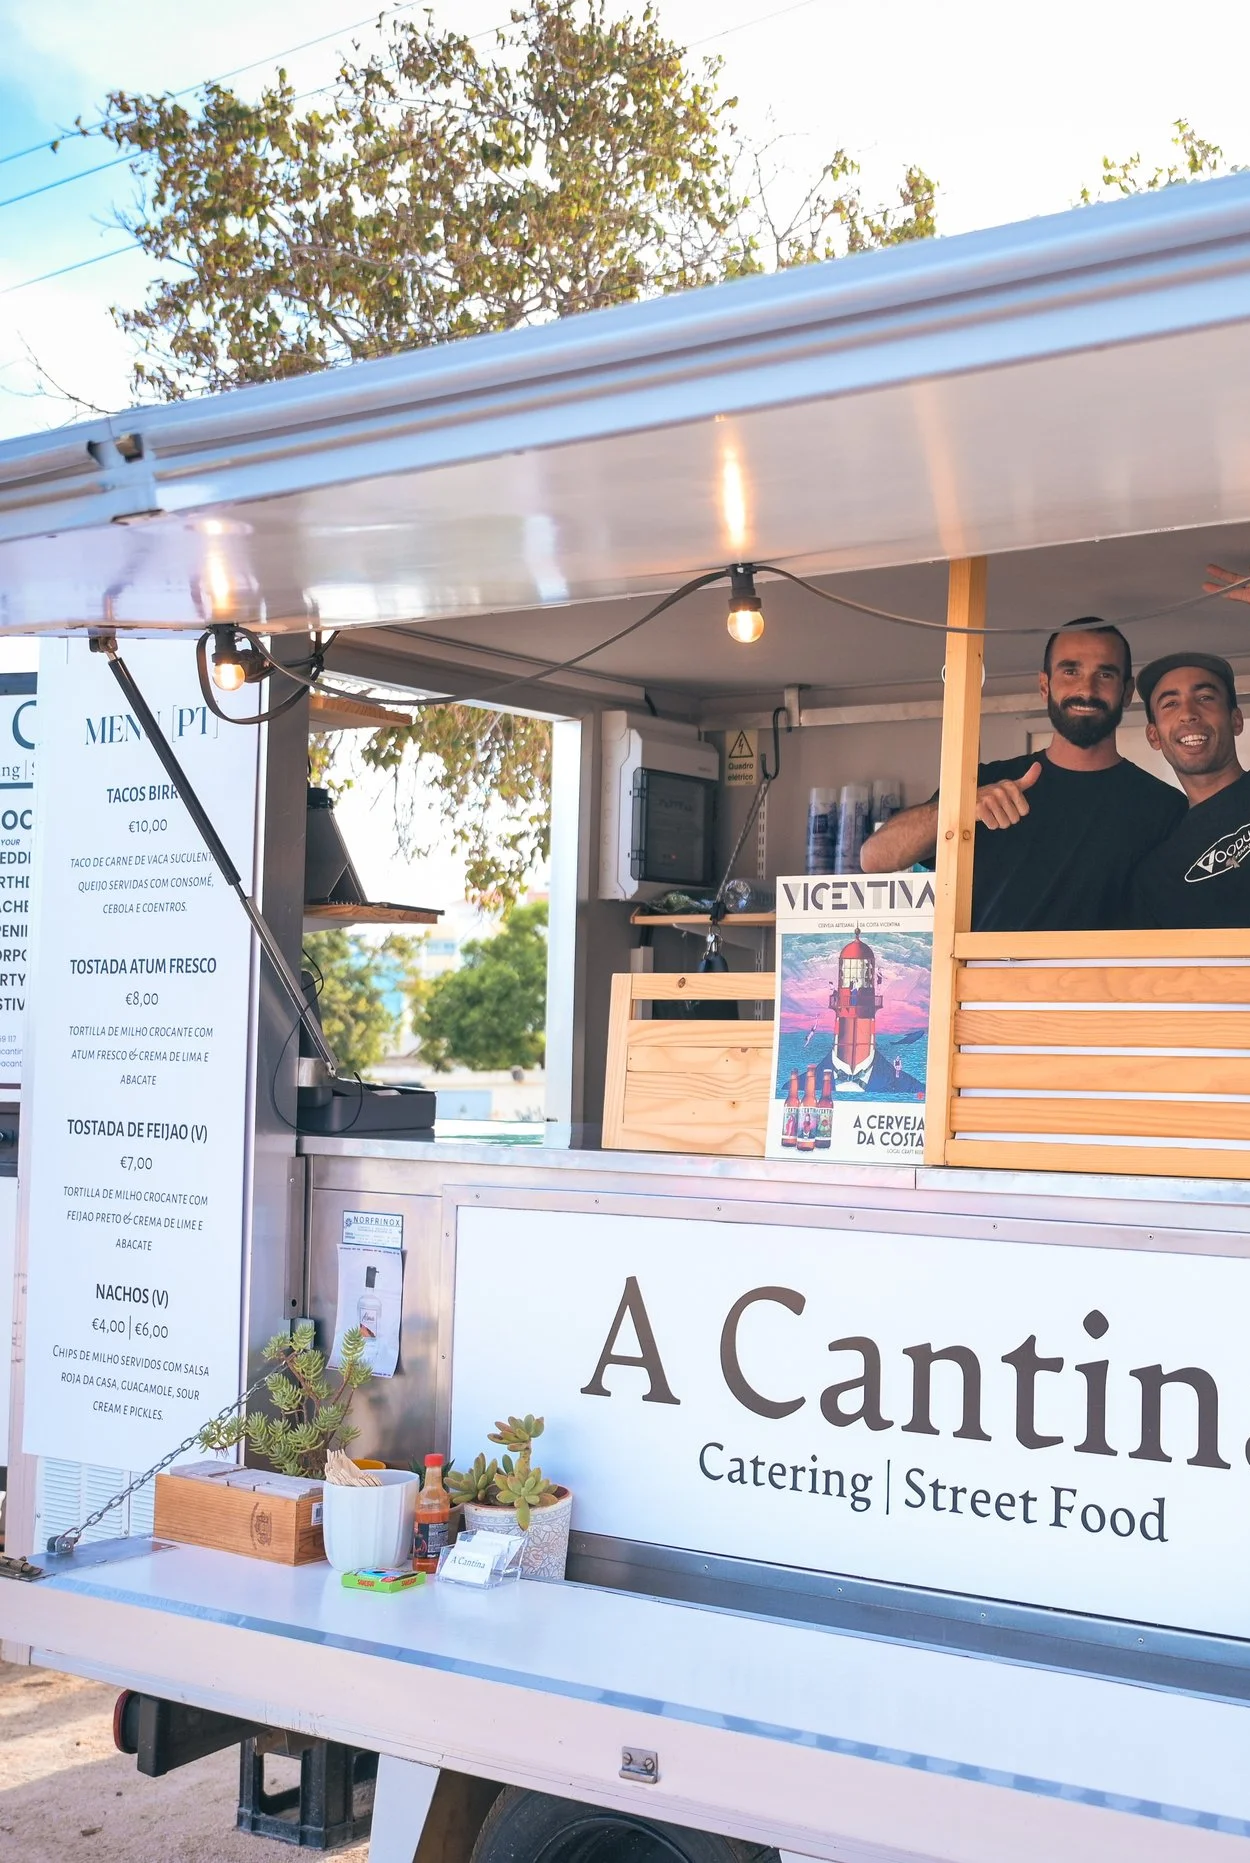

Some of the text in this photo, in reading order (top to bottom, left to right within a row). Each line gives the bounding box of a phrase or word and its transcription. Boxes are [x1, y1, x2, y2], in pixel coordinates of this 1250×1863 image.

[727, 762, 754, 771] Quadro
[727, 772, 754, 781] elétrico
[106, 786, 146, 803] TACOS
[128, 818, 168, 834] €10,00
[78, 872, 214, 893] QUEIJO SERVIDAS COM CONSOMÉ,
[782, 879, 935, 911] VICENTINA
[102, 901, 187, 914] CEBOLA E COENTROS.
[70, 957, 217, 975] TOSTADA ATUM FRESCO
[125, 991, 159, 1008] €8,00
[69, 1025, 213, 1038] TORTILLA DE MILHO CROCANTE COM
[120, 1074, 157, 1086] ABACATE
[853, 1114, 925, 1131] A CERVEJA
[67, 1119, 208, 1144] TOSTADA DE FEIJAO (V)
[857, 1131, 924, 1147] DA COSTA
[120, 1156, 153, 1172] €7,00
[353, 1216, 400, 1226] NORFRINOX
[115, 1238, 153, 1251] ABACATE
[96, 1283, 169, 1309] NACHOS (V)
[92, 1317, 169, 1339] €4,00 €6,00
[579, 1275, 682, 1407] A
[52, 1344, 209, 1376] CHIPS DE MILHO SERVIDOS COM SALSA
[61, 1372, 200, 1400] ROJA DA CASA, GUACAMOLE, SOUR
[92, 1400, 163, 1421] CREAM E PICKLES.
[698, 1441, 1169, 1544] Catering Street Food
[450, 1556, 485, 1569] A Cantina
